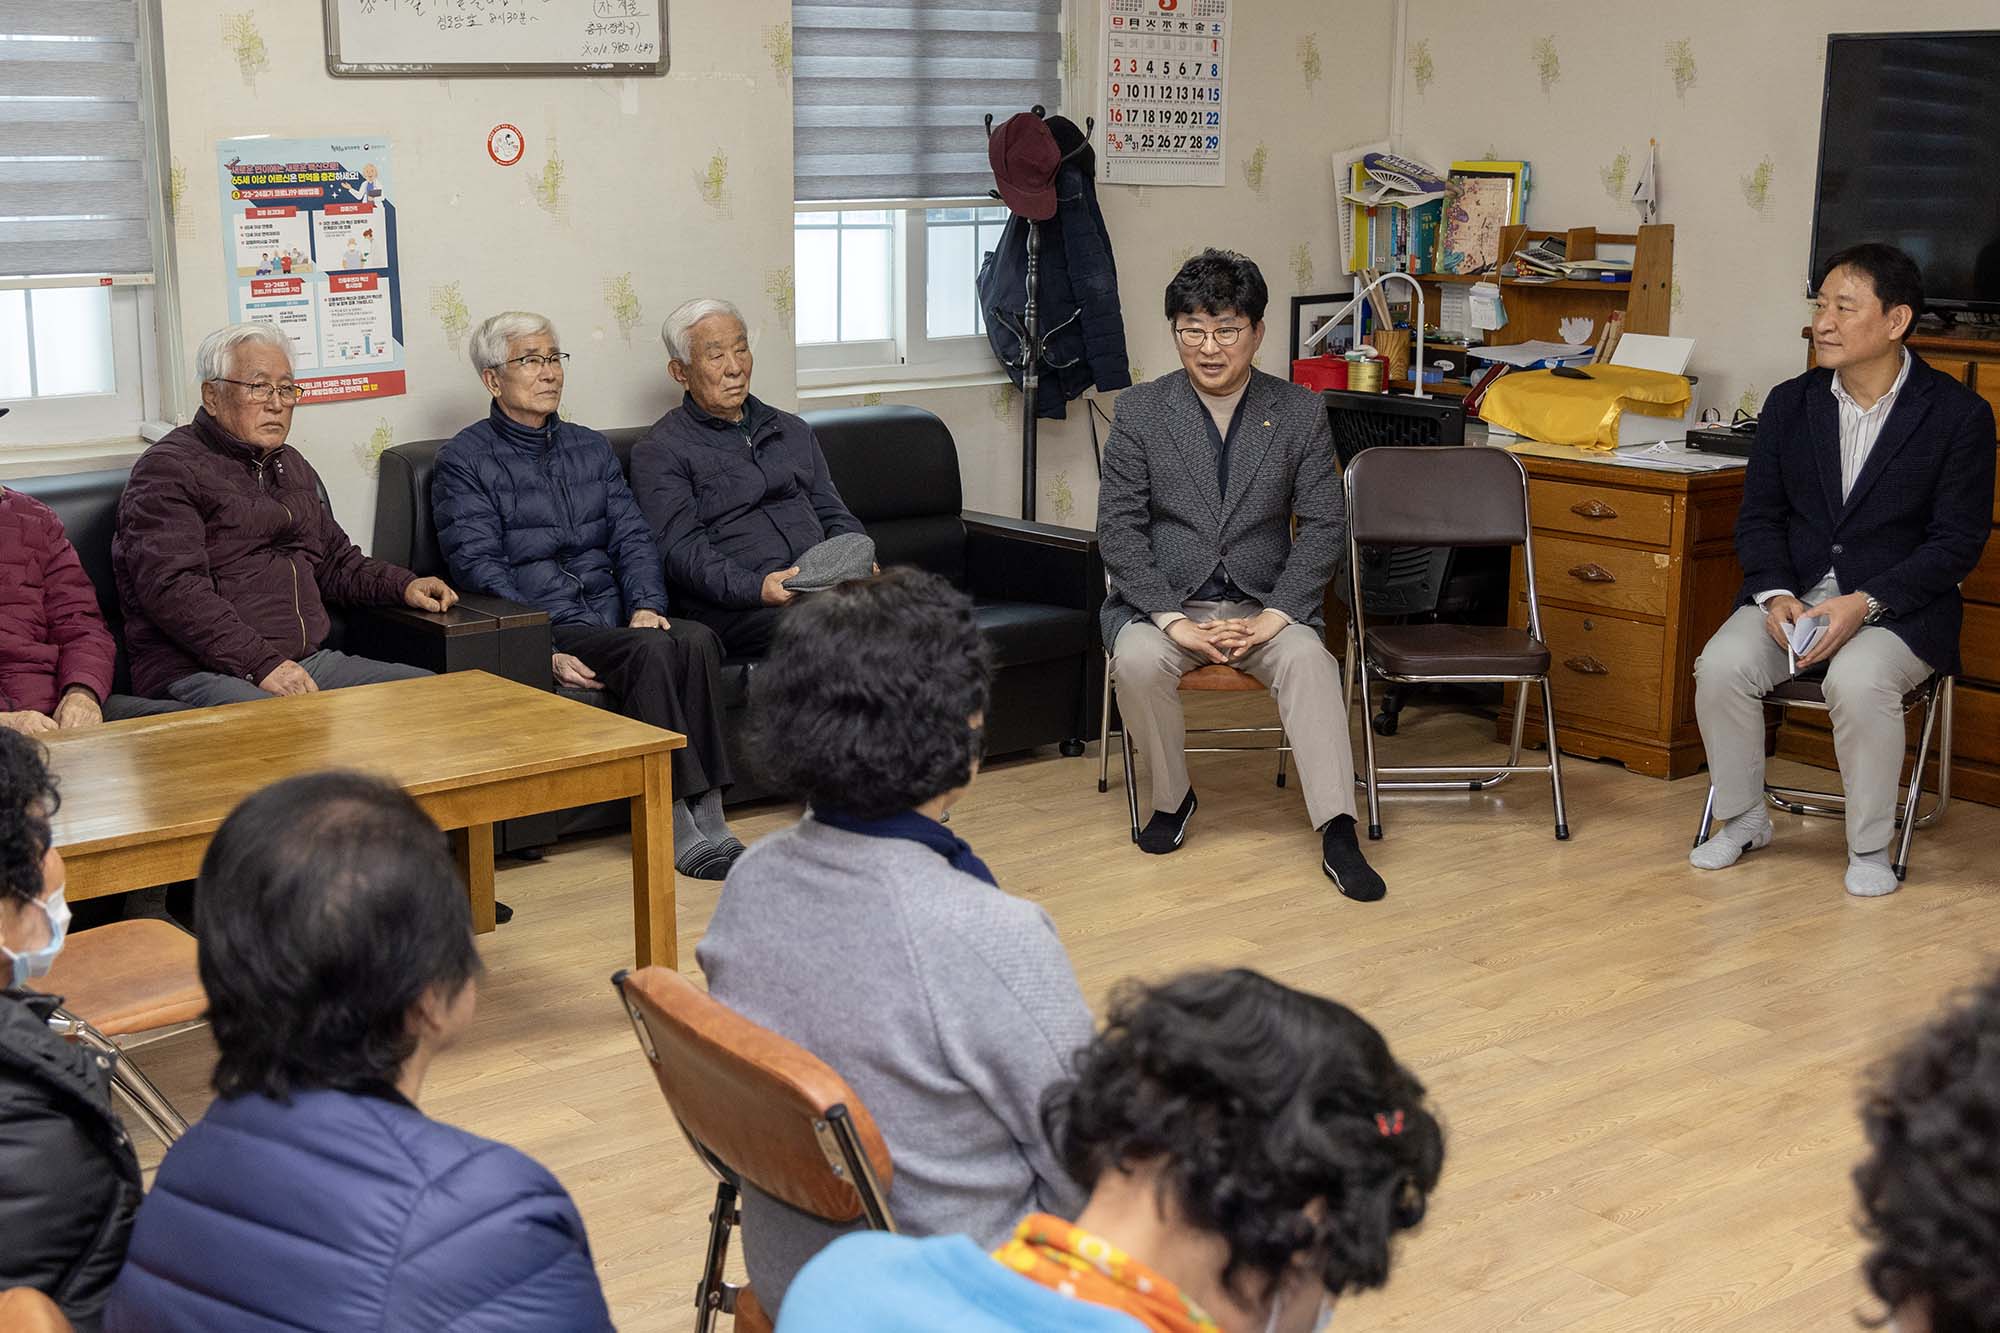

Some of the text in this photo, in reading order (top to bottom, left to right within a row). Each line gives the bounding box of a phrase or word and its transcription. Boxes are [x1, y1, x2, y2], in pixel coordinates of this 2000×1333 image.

[1113, 17, 1123, 25] 日
[1130, 18, 1139, 26] 月
[1162, 20, 1172, 28] 水
[1195, 22, 1205, 31] 金
[1212, 23, 1221, 32] 土
[1213, 39, 1217, 52] 1
[1114, 58, 1218, 76] 2 3 4 5 6 7 8
[1112, 84, 1219, 101] 9 10 11 12 13 14 15
[1110, 109, 1219, 125] 16 17 18 19 20 21 22
[1125, 134, 1132, 142] 24
[1142, 135, 1154, 147] 25
[1158, 135, 1170, 148] 26
[1174, 136, 1187, 148] 27
[1190, 136, 1202, 148] 28
[1206, 136, 1218, 149] 29
[231, 174, 250, 184] 65세
[252, 174, 266, 184] 이상
[268, 173, 297, 183] 어르신은
[298, 172, 320, 182] 면역을
